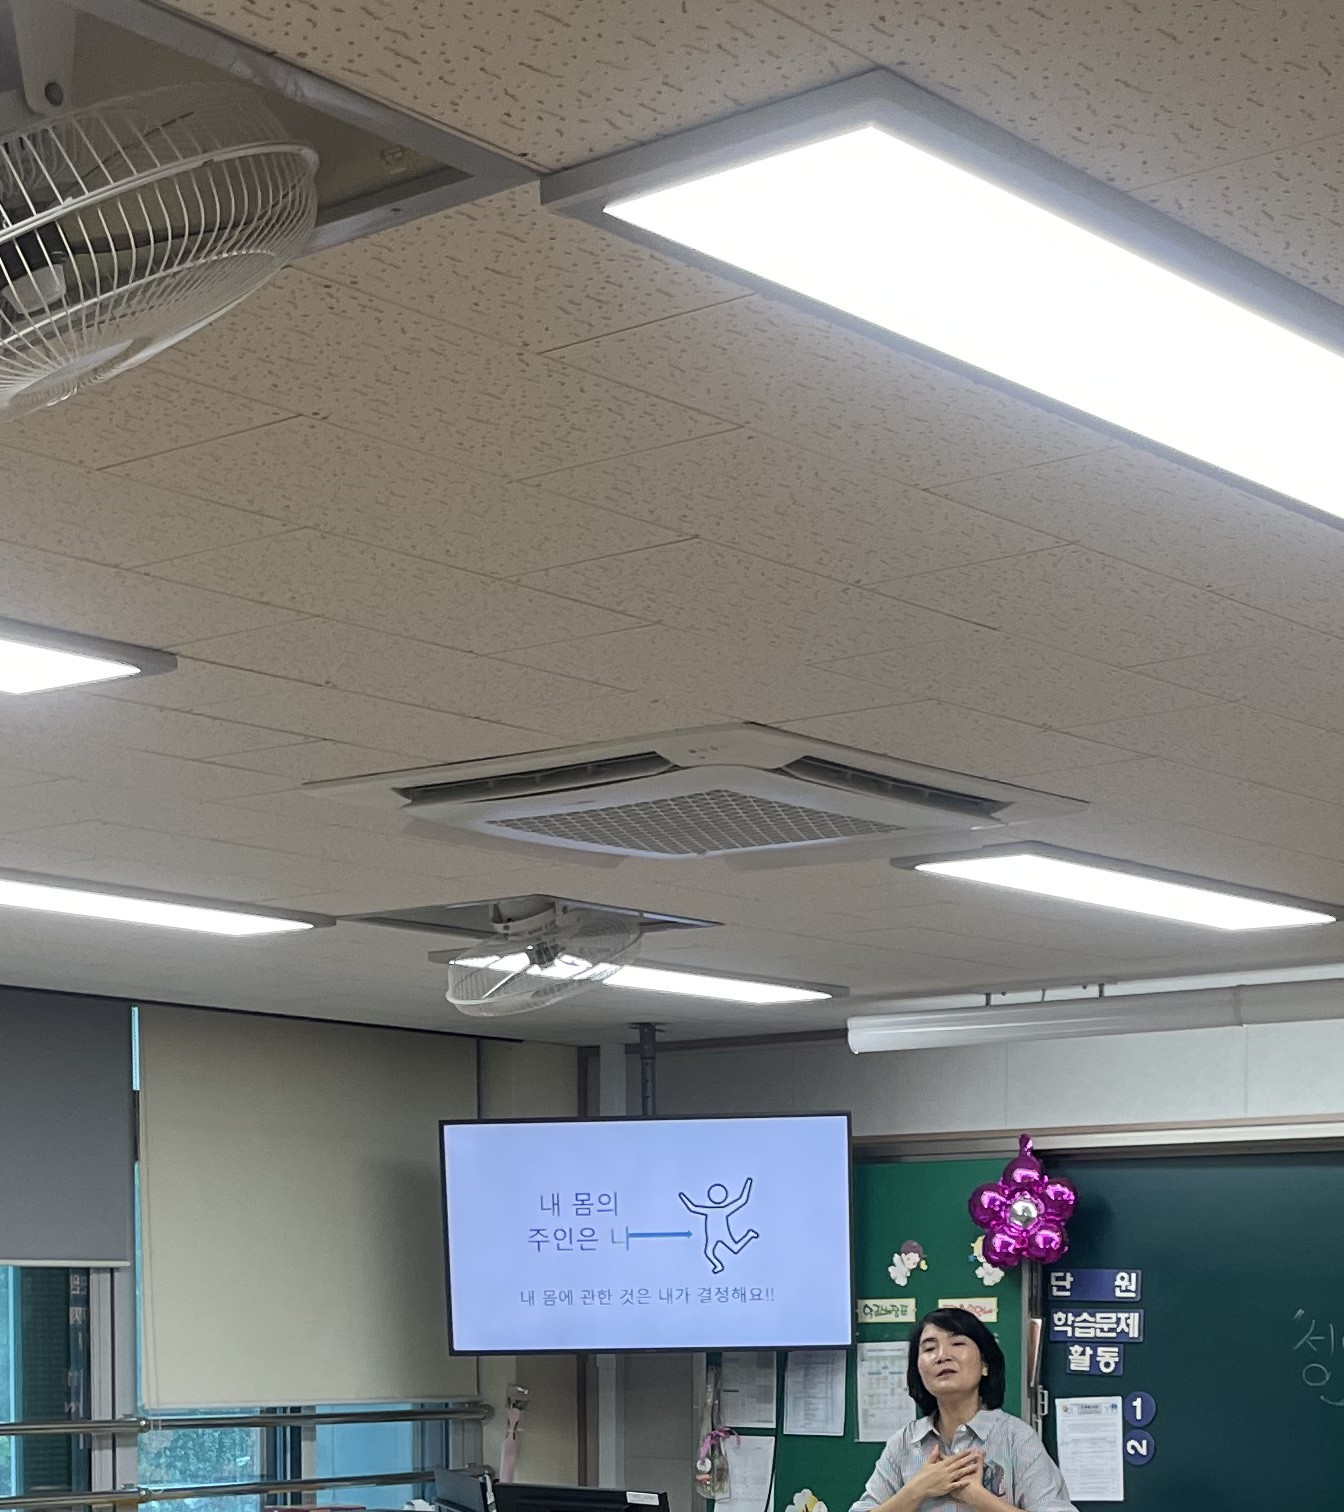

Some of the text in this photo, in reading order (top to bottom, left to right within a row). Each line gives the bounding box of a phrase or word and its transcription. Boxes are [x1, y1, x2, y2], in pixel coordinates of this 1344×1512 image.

[540, 1191, 619, 1217] 내 몸의
[528, 1226, 630, 1252] 주인은 나
[520, 1286, 775, 1306] 내 몸에 관한 것은 내가 결정해요!!
[1053, 1311, 1140, 1338] 학습문제
[1132, 1397, 1142, 1420] 1
[1126, 1439, 1148, 1456] 2
